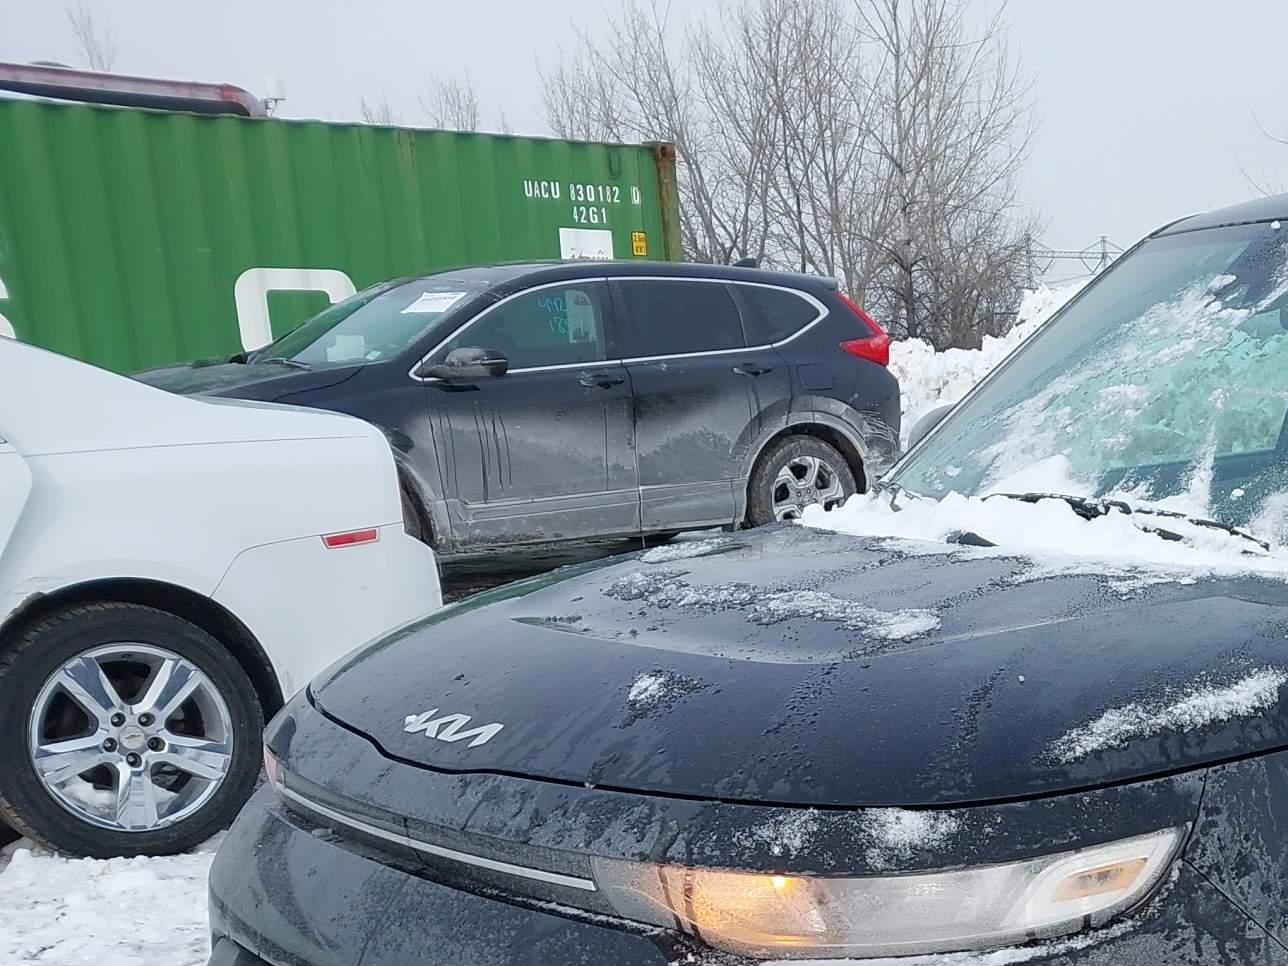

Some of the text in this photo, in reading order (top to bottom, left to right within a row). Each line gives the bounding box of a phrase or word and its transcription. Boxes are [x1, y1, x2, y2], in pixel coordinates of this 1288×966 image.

[523, 180, 560, 198] UACU
[569, 183, 621, 203] 830182
[572, 206, 607, 224] 42G1
[404, 708, 504, 748] KIA
